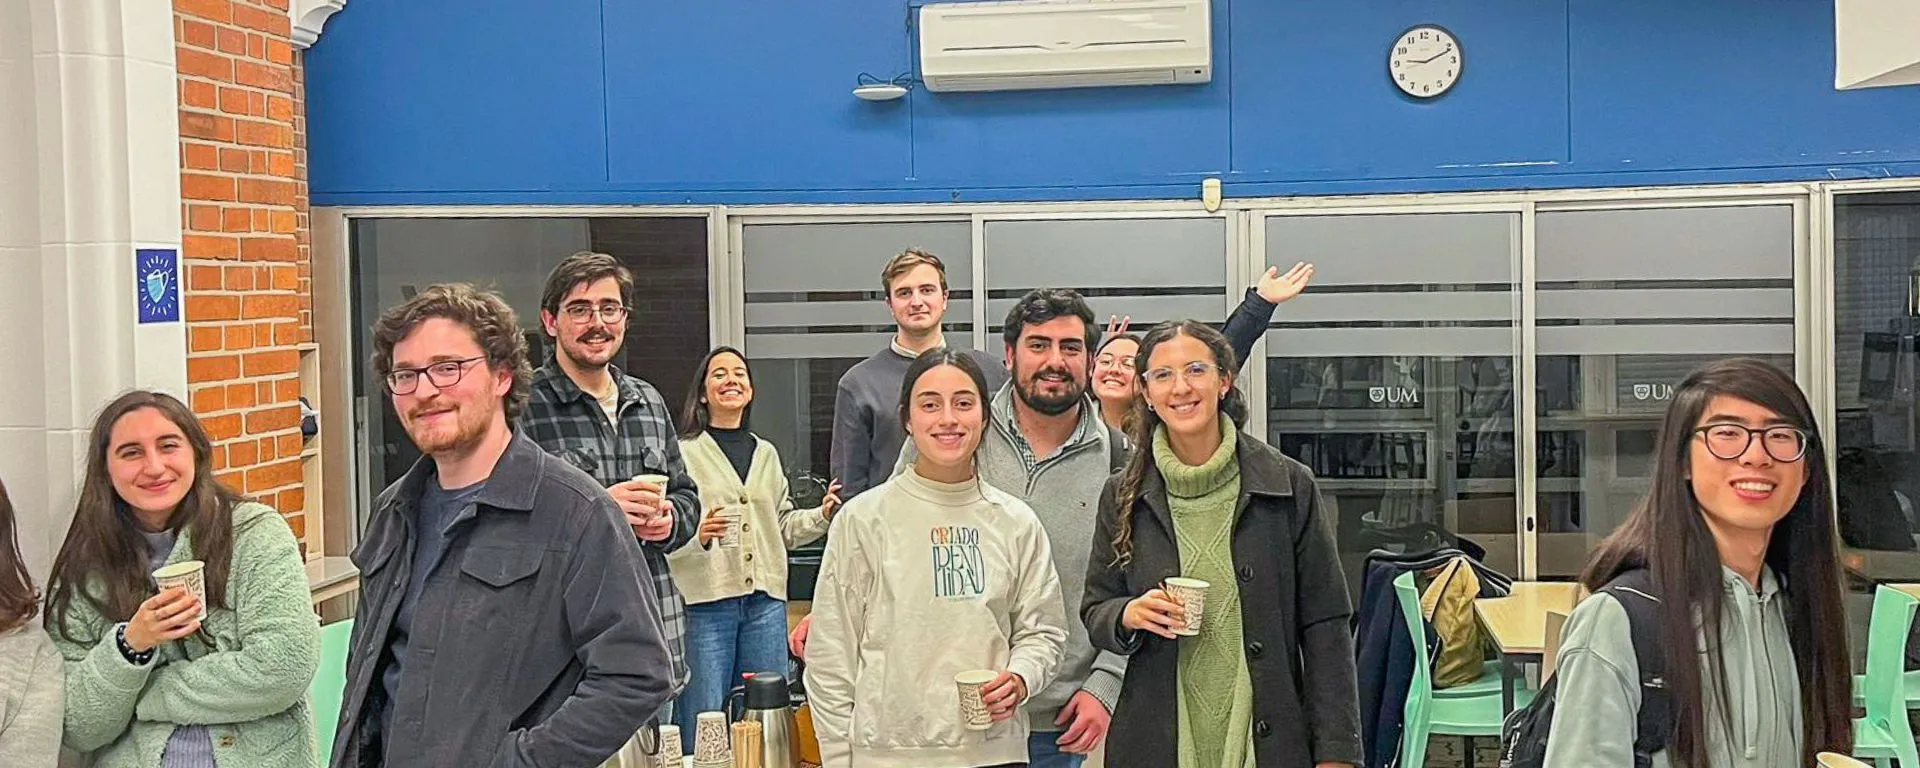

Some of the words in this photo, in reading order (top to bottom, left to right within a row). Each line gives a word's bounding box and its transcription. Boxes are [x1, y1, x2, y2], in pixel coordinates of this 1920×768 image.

[1420, 31, 1429, 40] 12
[1407, 36, 1415, 44] 11
[1397, 47, 1407, 55] 10
[1450, 55, 1456, 64] 3
[1394, 60, 1400, 68] 9
[1399, 73, 1405, 81] 8
[1447, 69, 1452, 77] 4
[1410, 82, 1415, 90] 7
[1436, 80, 1443, 88] 5
[1423, 84, 1430, 93] 6
[1386, 386, 1419, 403] UM
